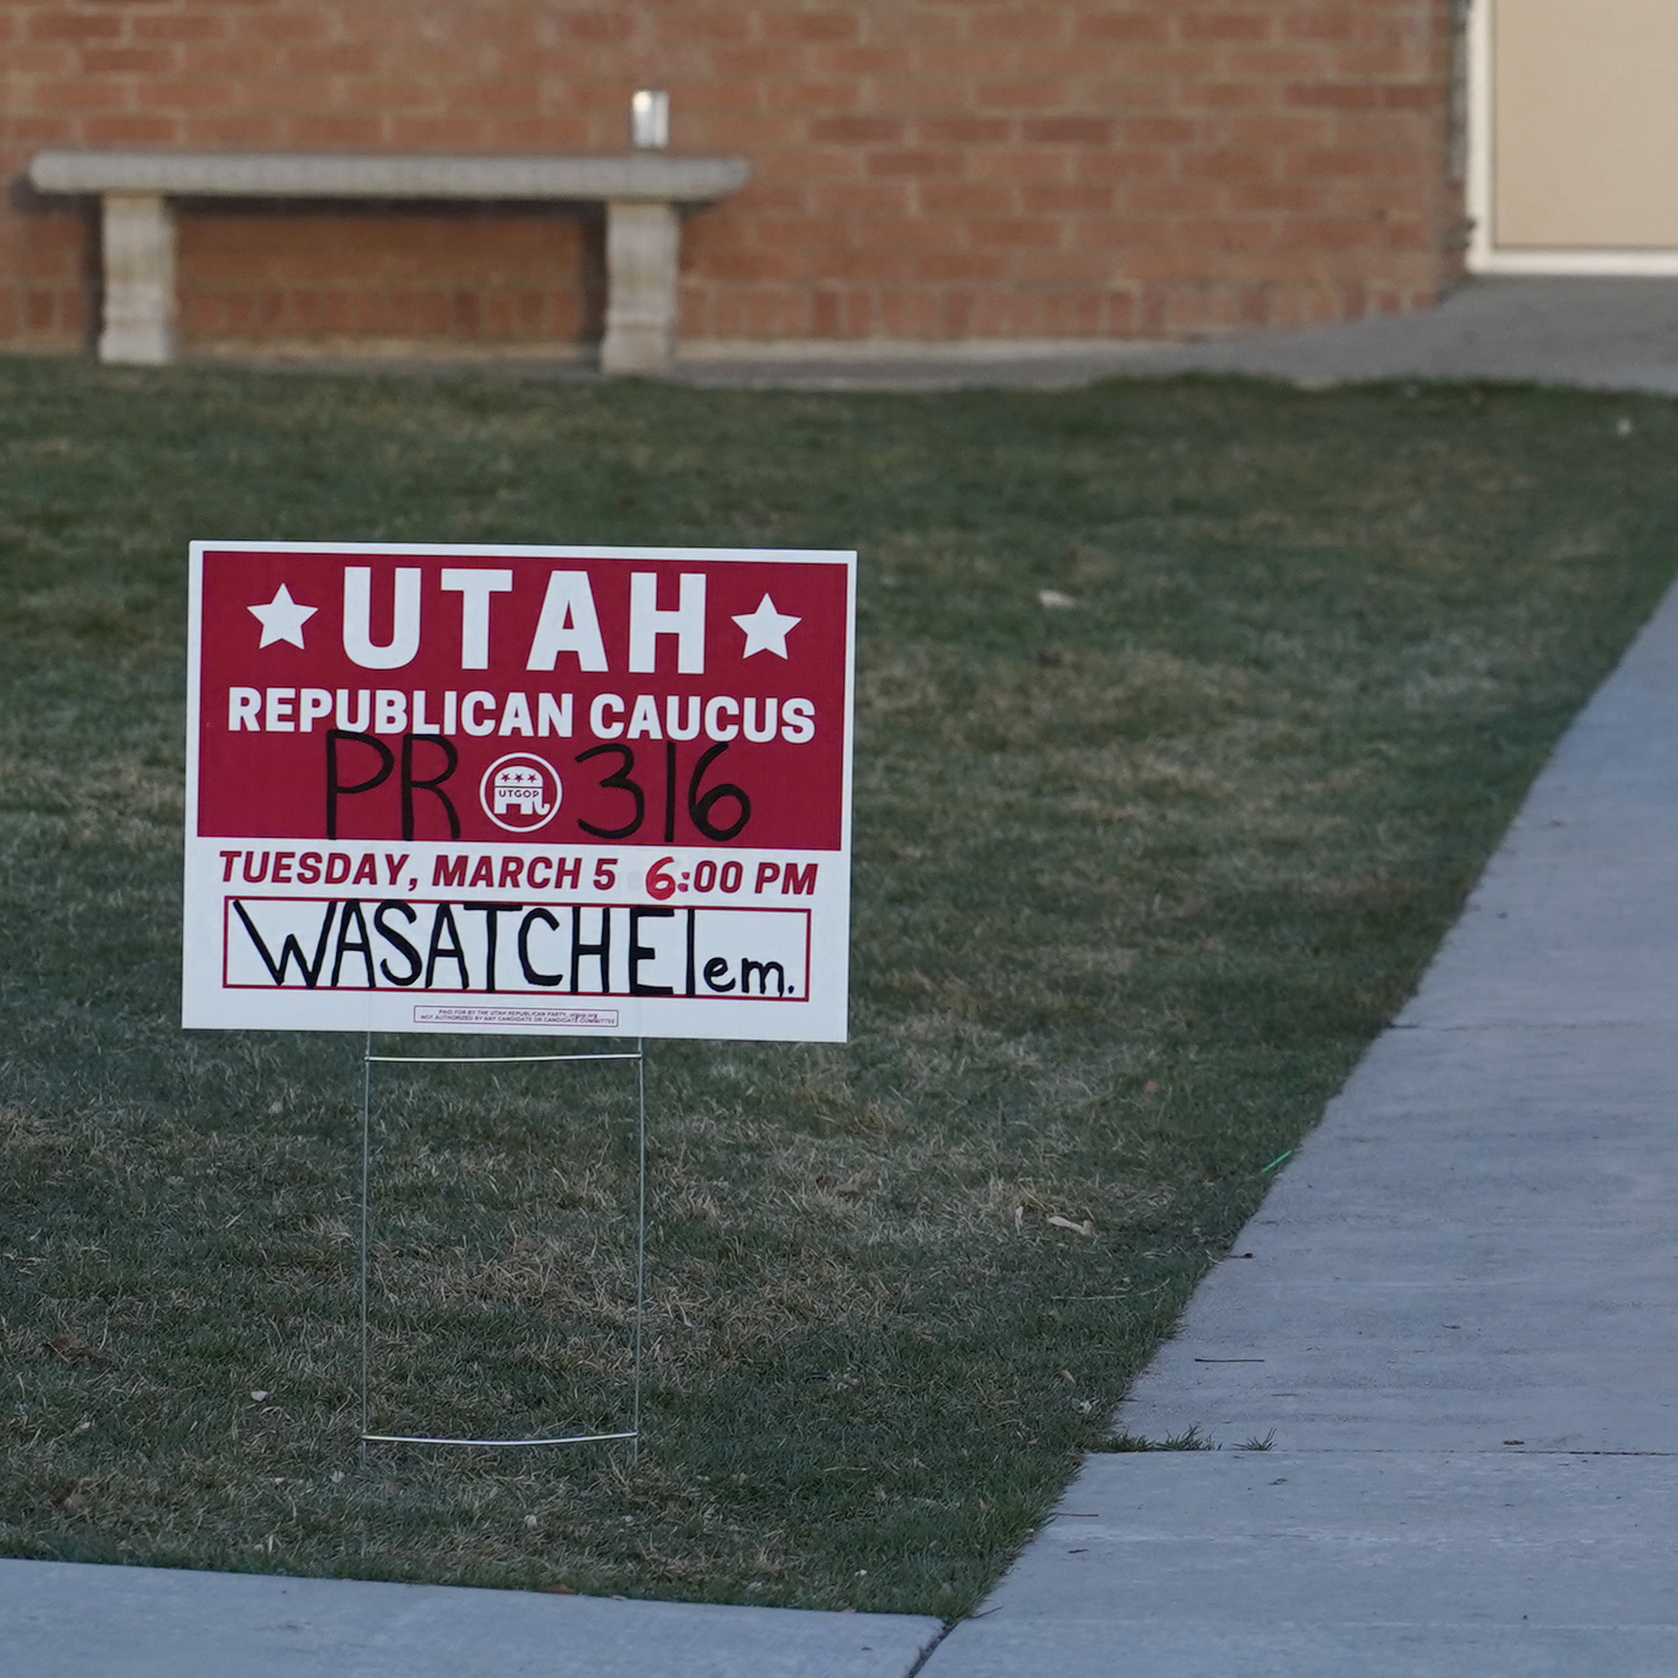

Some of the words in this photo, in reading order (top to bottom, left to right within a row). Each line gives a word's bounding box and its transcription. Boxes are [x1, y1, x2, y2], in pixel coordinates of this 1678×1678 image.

[343, 566, 707, 674] UTAH
[227, 687, 573, 737] REPUBLICAN
[590, 693, 816, 743] CAUCUS
[326, 729, 461, 841] PR
[574, 741, 751, 844] 316
[498, 788, 540, 799] UTGOP
[219, 850, 418, 890] TUESDAY,
[432, 854, 581, 890] MARCH
[592, 858, 617, 891] 5
[645, 856, 744, 899] 6:00
[754, 861, 818, 895] PM
